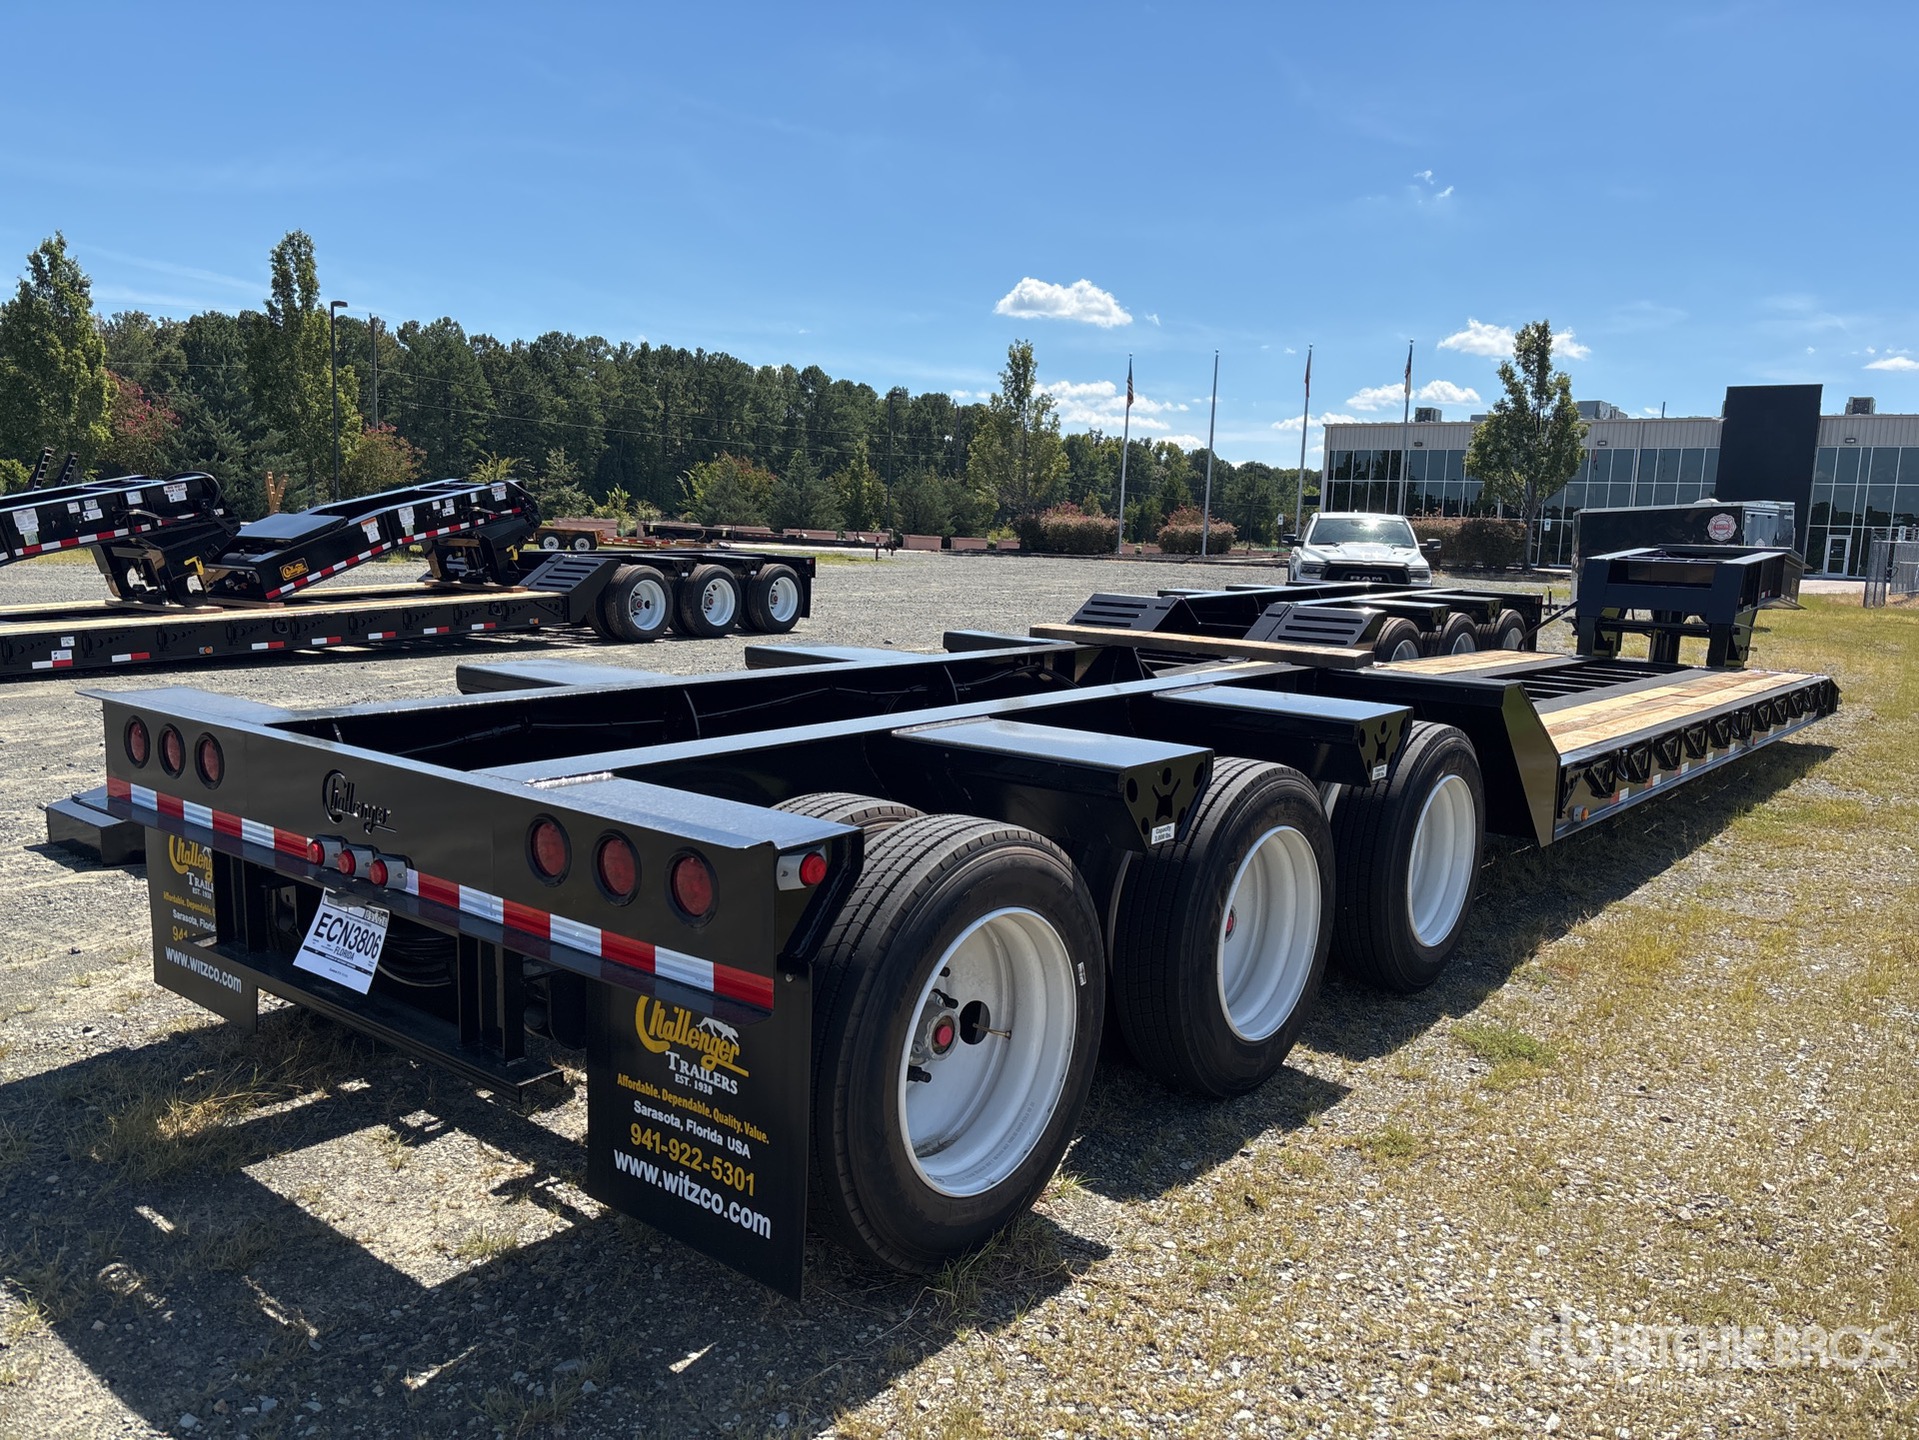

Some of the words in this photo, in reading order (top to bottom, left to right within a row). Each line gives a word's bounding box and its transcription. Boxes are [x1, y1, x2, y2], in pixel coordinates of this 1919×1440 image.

[322, 769, 397, 835] Challenger
[172, 908, 199, 927] Sarasota,
[313, 911, 382, 959] ECN3806
[165, 945, 242, 993] www.witzco.com
[332, 945, 356, 961] FLORIDA
[635, 994, 749, 1078] Challenger
[665, 1050, 738, 1095] TRAILERS
[674, 1073, 692, 1088] EST.
[694, 1080, 714, 1096] 1938
[617, 1073, 661, 1099] Affordable.
[661, 1089, 712, 1119] Dependable.
[713, 1108, 743, 1134] Quality.
[744, 1121, 770, 1145] Value.
[633, 1100, 684, 1131] Sarasota,
[686, 1118, 723, 1146] Florida
[727, 1136, 751, 1159] USA
[630, 1123, 755, 1197] 941-922-5301
[614, 1149, 772, 1240] www.witzco.com
